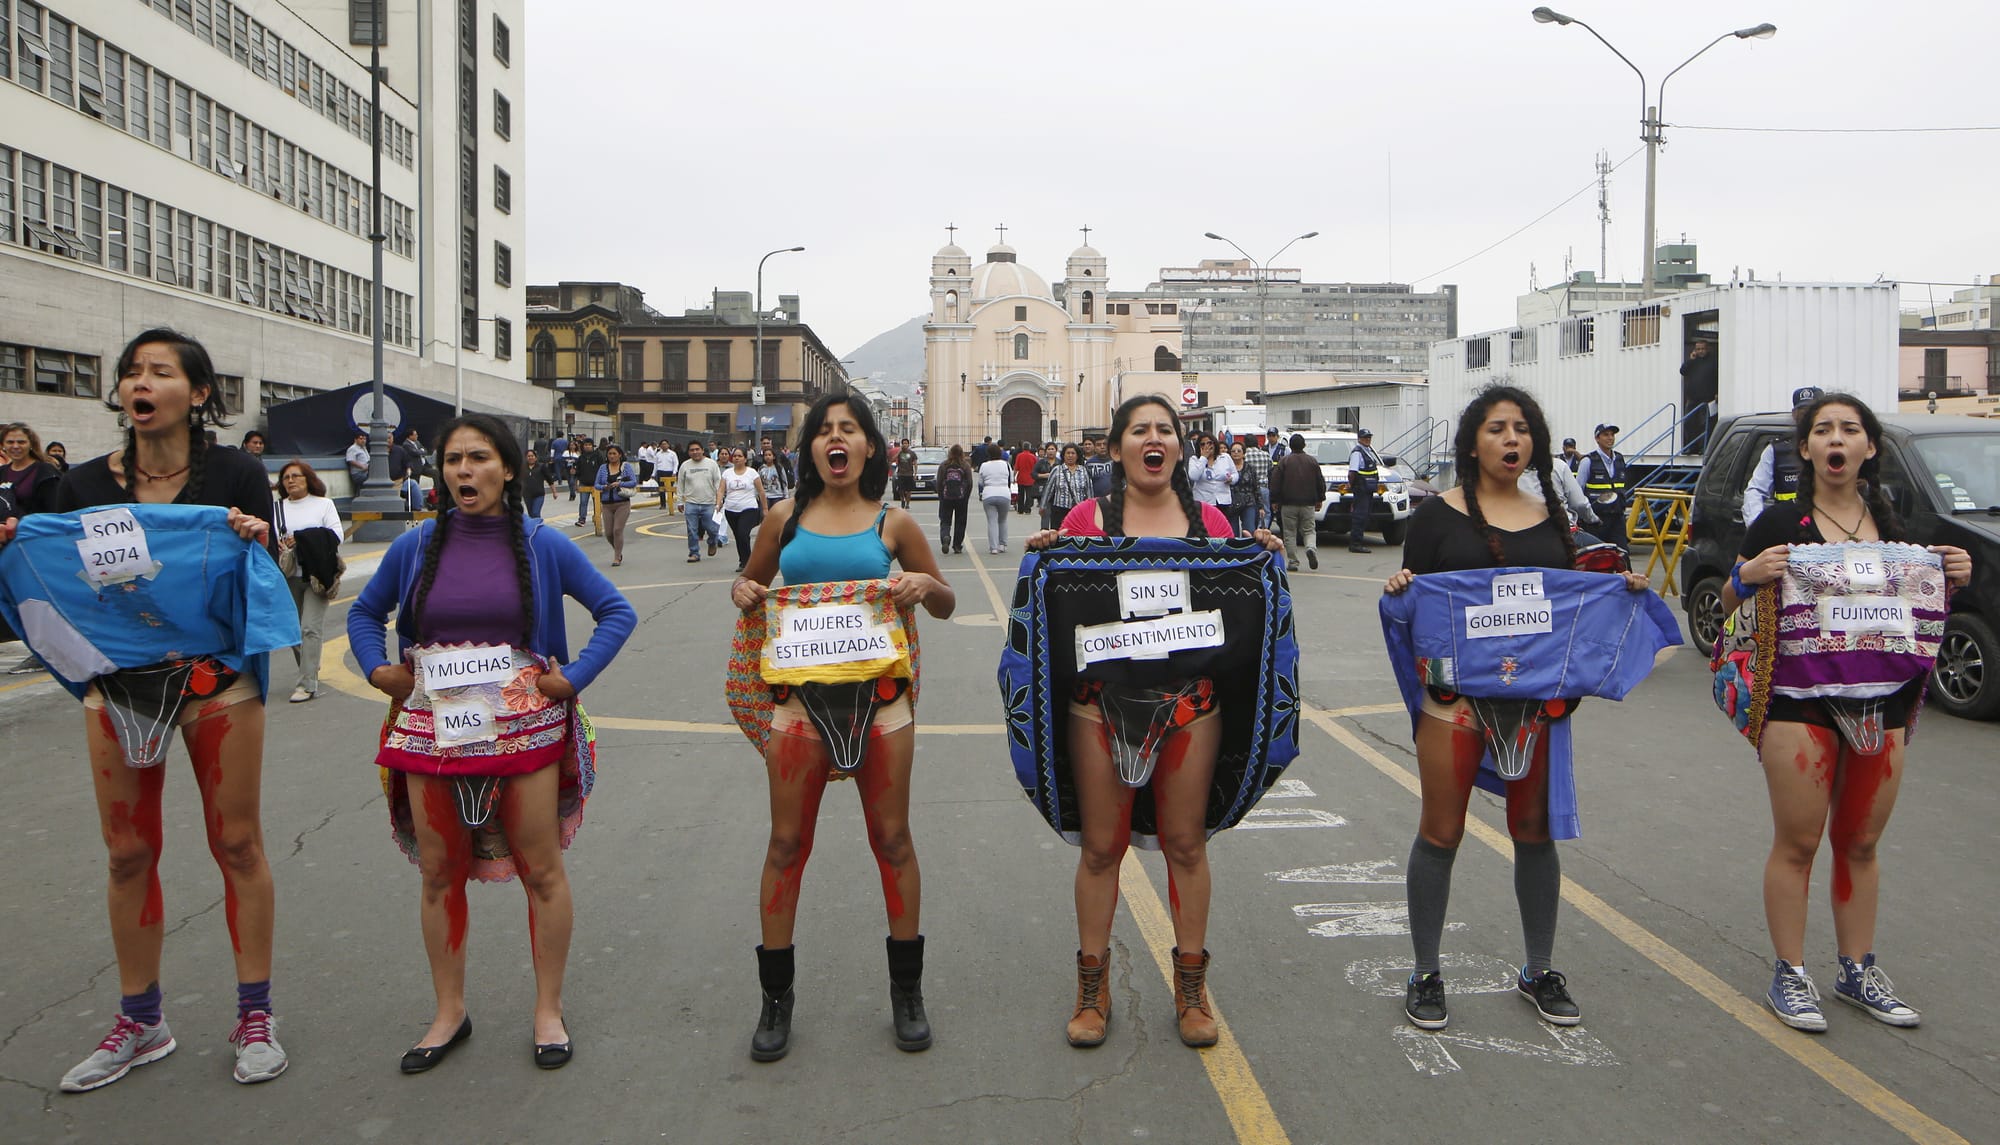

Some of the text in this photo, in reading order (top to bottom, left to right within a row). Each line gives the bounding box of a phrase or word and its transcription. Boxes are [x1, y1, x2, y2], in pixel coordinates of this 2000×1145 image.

[93, 520, 134, 537] SON
[92, 546, 140, 567] 2074
[1854, 562, 1875, 575] DE
[1130, 583, 1179, 600] SIN SU
[1497, 583, 1539, 598] EN EL
[1470, 610, 1550, 629] GOBIERNO
[1832, 606, 1903, 621] FUJIMORI
[793, 614, 863, 633] MUJERES
[1084, 623, 1217, 653] CONSENTIMIENTO
[776, 636, 888, 660] ESTERILIZADAS
[427, 656, 511, 679] Y MUCHAS
[445, 710, 482, 729] MÁS
